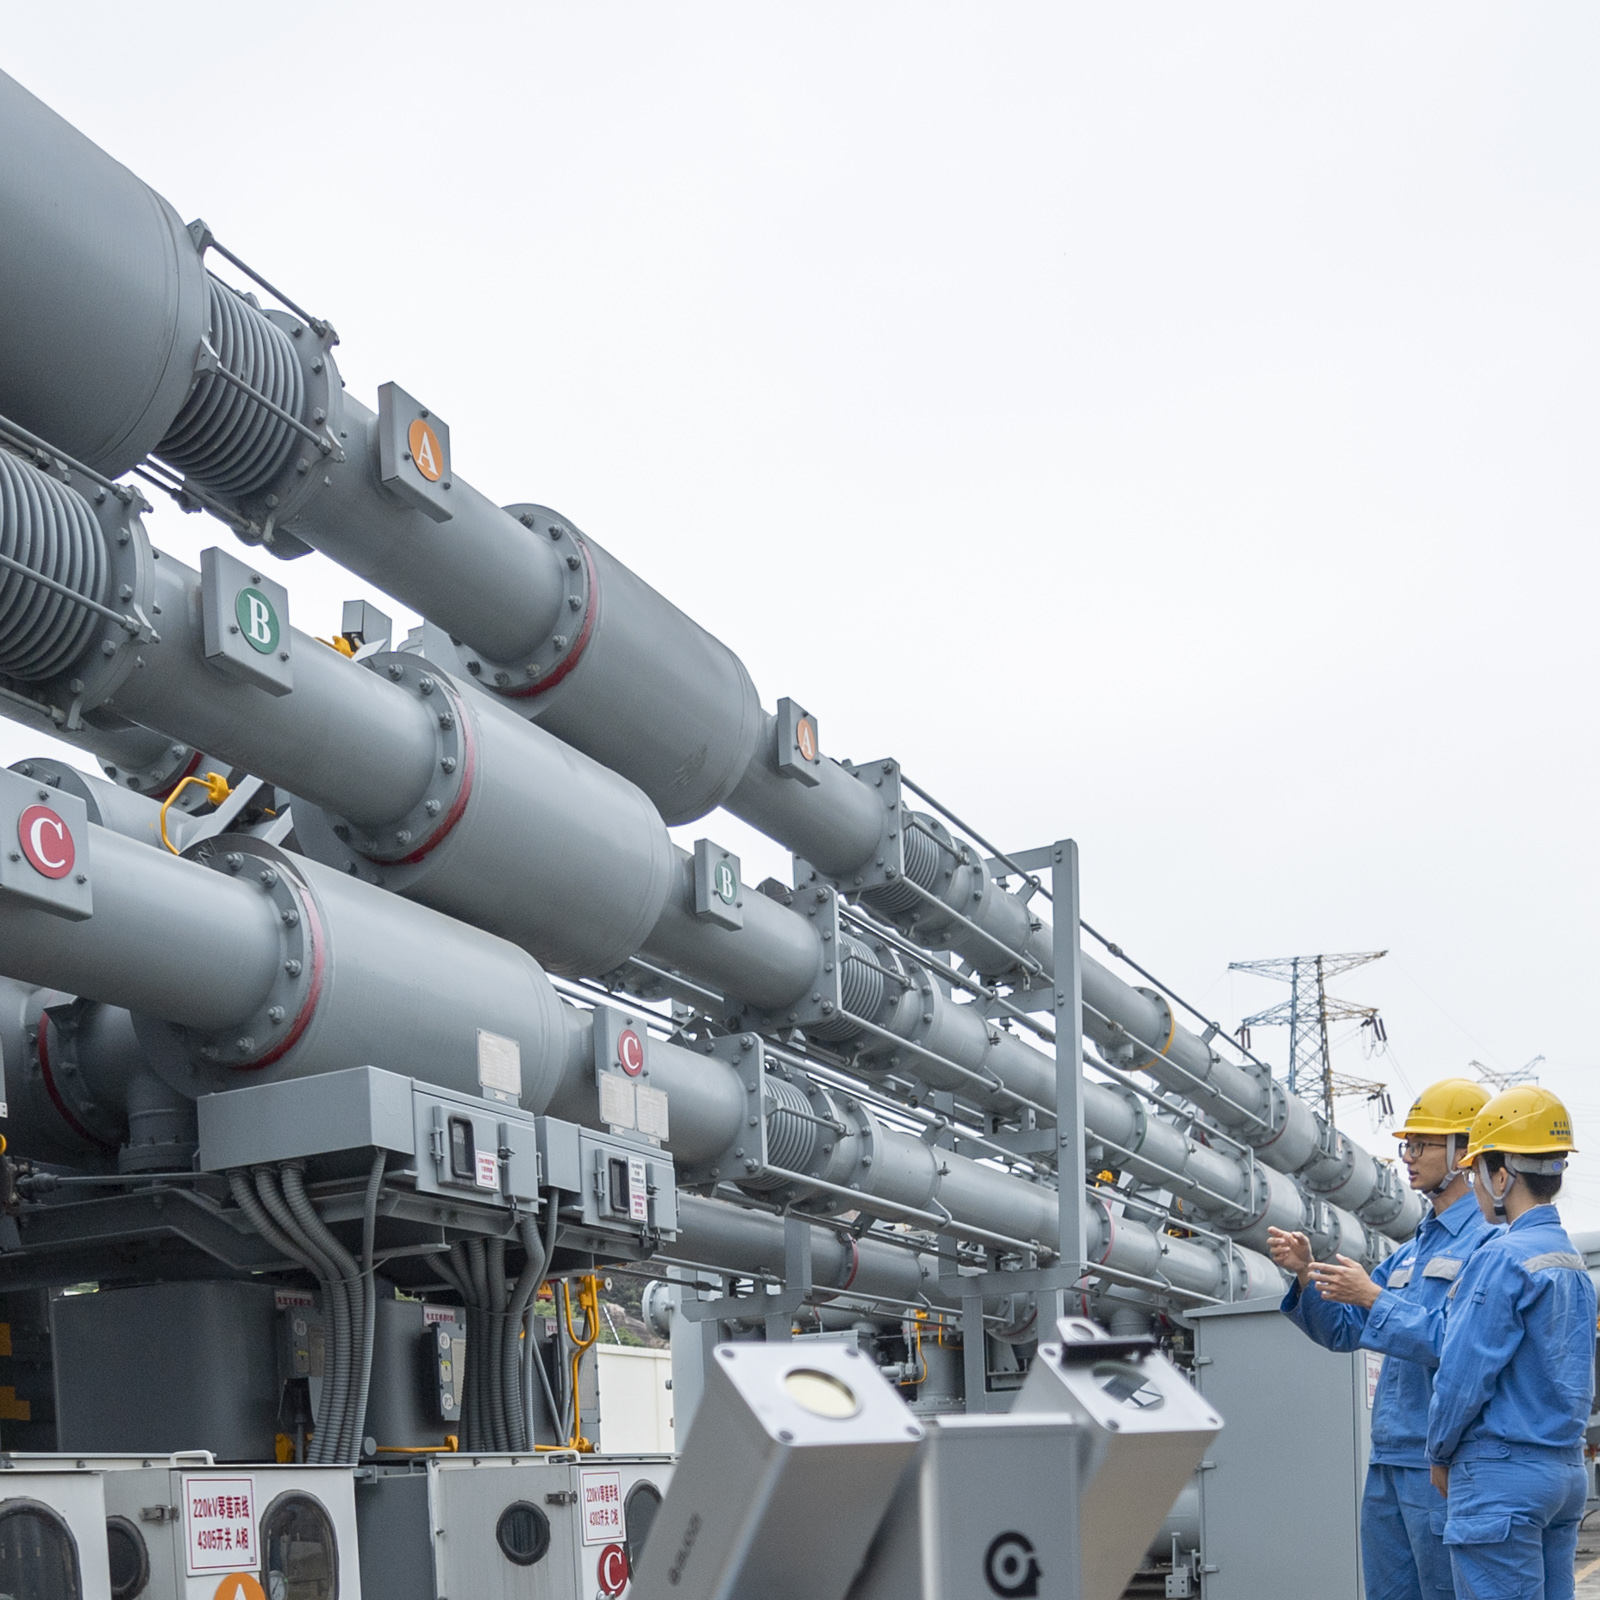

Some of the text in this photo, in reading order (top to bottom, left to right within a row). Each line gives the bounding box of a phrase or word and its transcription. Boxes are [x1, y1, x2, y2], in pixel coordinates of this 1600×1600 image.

[417, 431, 439, 476] A
[246, 593, 271, 644] B
[801, 726, 813, 757] A
[30, 817, 66, 869] C
[720, 865, 733, 898] B
[623, 1036, 639, 1070] C
[193, 1495, 250, 1519] 220kV琴莲丙线
[197, 1526, 249, 1551] 4305开关 A相
[603, 1551, 623, 1590] C
